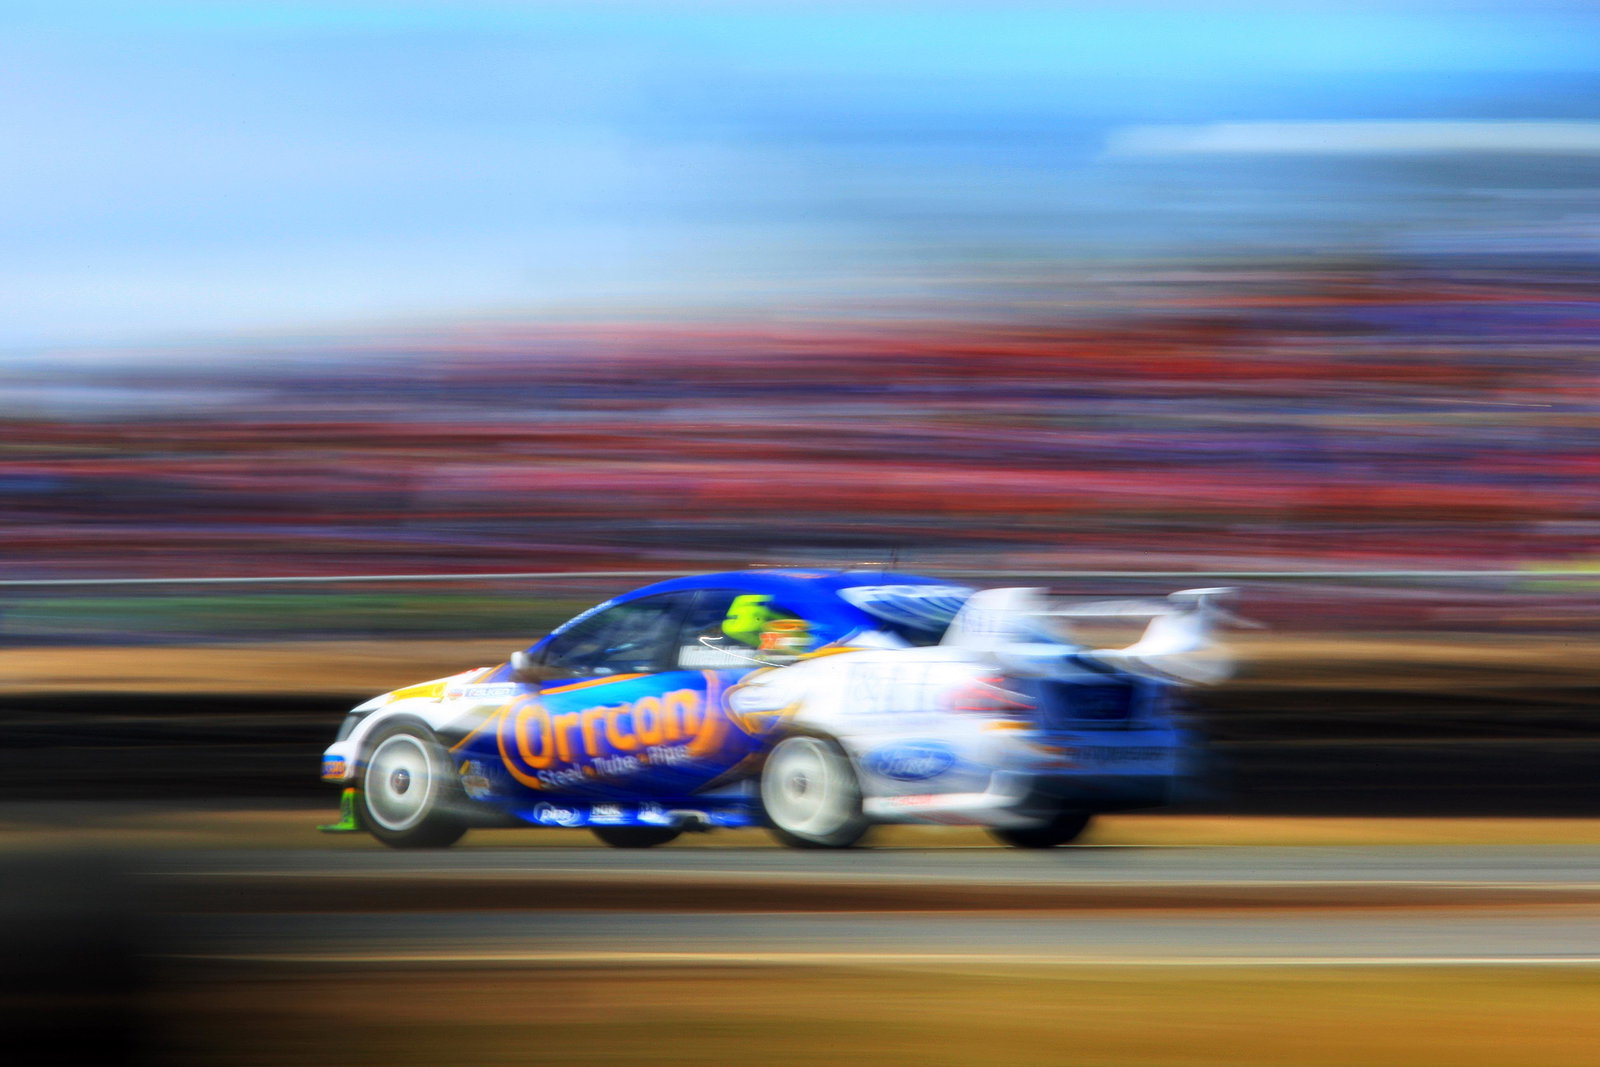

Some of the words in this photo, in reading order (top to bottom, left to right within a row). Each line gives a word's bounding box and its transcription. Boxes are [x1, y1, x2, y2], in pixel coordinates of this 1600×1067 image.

[722, 594, 777, 638] 5
[514, 688, 702, 768] Orrcon
[537, 763, 584, 788] Steel
[591, 754, 638, 776] Tube
[647, 744, 690, 766] Pipe
